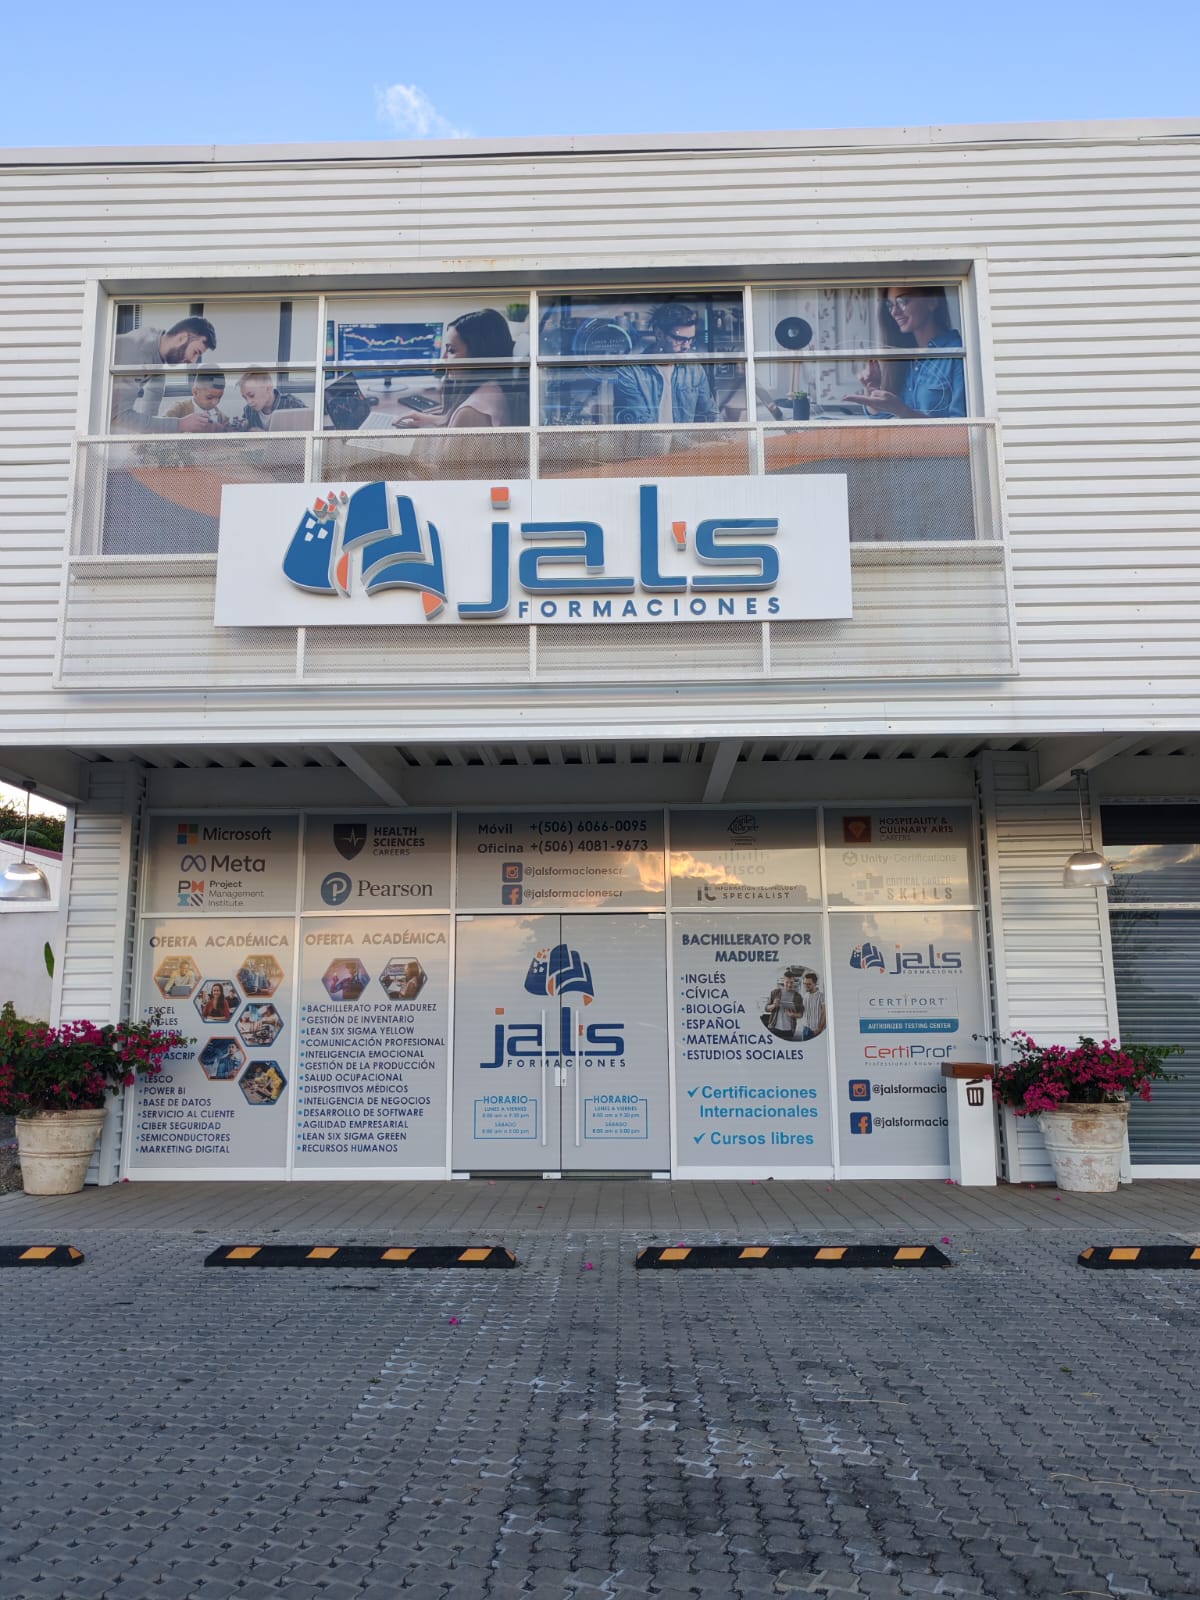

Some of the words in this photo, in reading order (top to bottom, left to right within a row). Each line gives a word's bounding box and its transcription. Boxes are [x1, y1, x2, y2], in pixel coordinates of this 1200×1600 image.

[519, 597, 781, 619] FORMACIONES
[879, 816, 937, 826] HOSPITALITY
[374, 826, 417, 836] HEALTH
[478, 823, 513, 834] Móvil
[530, 820, 573, 835] +(506)
[577, 820, 647, 832] 6066-0095
[879, 826, 928, 834] CULINARY
[931, 825, 954, 833] ARTS
[203, 826, 272, 840] Microsoft
[373, 838, 425, 847] SCIENCES
[478, 843, 524, 854] Oficina
[530, 840, 574, 854] +(506)
[578, 840, 648, 852] 4081-9673
[211, 855, 266, 872] Meta
[860, 853, 888, 865] Unity
[210, 880, 242, 889] Project
[358, 880, 433, 897] Pearson
[208, 890, 264, 899] Management
[887, 888, 953, 900] SKILLS
[150, 936, 198, 948] OFERTA
[205, 932, 289, 948] ACADÉMICA
[304, 934, 354, 946] OFERTA
[362, 930, 446, 945] ACADÉMICA
[682, 934, 780, 946] BACHILLERATO
[784, 934, 812, 945] POR
[715, 950, 780, 962] MADUREZ
[685, 971, 726, 984] INGLÉS
[685, 986, 729, 999] CÍVICA
[868, 995, 944, 1006] CERTIPORT
[148, 1006, 176, 1014] EXCEL
[307, 1004, 372, 1012] BACHILLERATO
[374, 1004, 392, 1012] POR
[394, 1004, 438, 1012] MADUREZ
[686, 1002, 746, 1014] BIOLOGÍA
[306, 1014, 345, 1024] GESTIÓN
[361, 1015, 414, 1023] INVENTARIO
[686, 1017, 740, 1030] ESPAÑOL
[306, 1027, 328, 1035] LEAN
[347, 1026, 377, 1034] SIGMA
[380, 1026, 414, 1034] YELLOW
[306, 1036, 382, 1047] COMUNICACIÓN
[385, 1038, 446, 1046] PROFESIONAL
[686, 1032, 774, 1045] MATEMÁTICAS
[150, 1052, 196, 1060] AVASCRIP
[305, 1050, 366, 1058] INTELIGENCIA
[368, 1050, 424, 1058] EMOCIONAL
[687, 1050, 742, 1060] ESTUDIOS
[746, 1050, 804, 1060] SOCIALES
[305, 1060, 344, 1070] GESTIÓN
[346, 1062, 358, 1070] DE
[373, 1060, 436, 1070] PRODUCCIÓN
[507, 1059, 626, 1068] FORMACONES
[144, 1075, 174, 1084] LESCO
[304, 1074, 332, 1082] SALUD
[335, 1073, 403, 1082] OCUPACIONAL
[144, 1086, 176, 1095] POWER
[178, 1086, 186, 1095] BI
[304, 1085, 364, 1094] DISPOSITIVOS
[366, 1084, 408, 1092] MÉDICOS
[702, 1086, 817, 1099] Certificaciones
[872, 1084, 948, 1096] @jalsformacio
[143, 1098, 166, 1106] BASE
[168, 1098, 180, 1106] DE
[182, 1098, 212, 1106] DATOS
[304, 1097, 364, 1105] INTELIGENCIA
[381, 1096, 431, 1104] NEGOCIOS
[483, 1095, 528, 1104] HORARIO
[593, 1095, 639, 1104] HORARIO
[142, 1110, 184, 1118] SERVICIO
[186, 1110, 198, 1118] AL
[200, 1110, 236, 1118] CLIENTE
[304, 1109, 360, 1117] DESARROLLO
[364, 1108, 375, 1116] DE
[377, 1108, 424, 1116] SOFTWARE
[700, 1105, 818, 1118] Internacionales
[141, 1122, 167, 1130] CIBER
[170, 1122, 222, 1130] SEGURIDAD
[302, 1120, 346, 1128] AGILIDAD
[350, 1120, 408, 1128] EMPRESARIAL
[873, 1116, 948, 1128] @jalsformacio
[140, 1134, 230, 1142] SEMICONDUCTORES
[302, 1132, 325, 1140] LEAN
[344, 1132, 374, 1140] SIGMA
[377, 1132, 406, 1140] GREEN
[710, 1132, 766, 1145] Cursos
[771, 1132, 814, 1145] libres
[140, 1146, 192, 1154] MARKETING
[195, 1145, 230, 1154] DIGITAL
[302, 1144, 348, 1152] RECURSOS
[351, 1144, 398, 1152] HUMANOS
